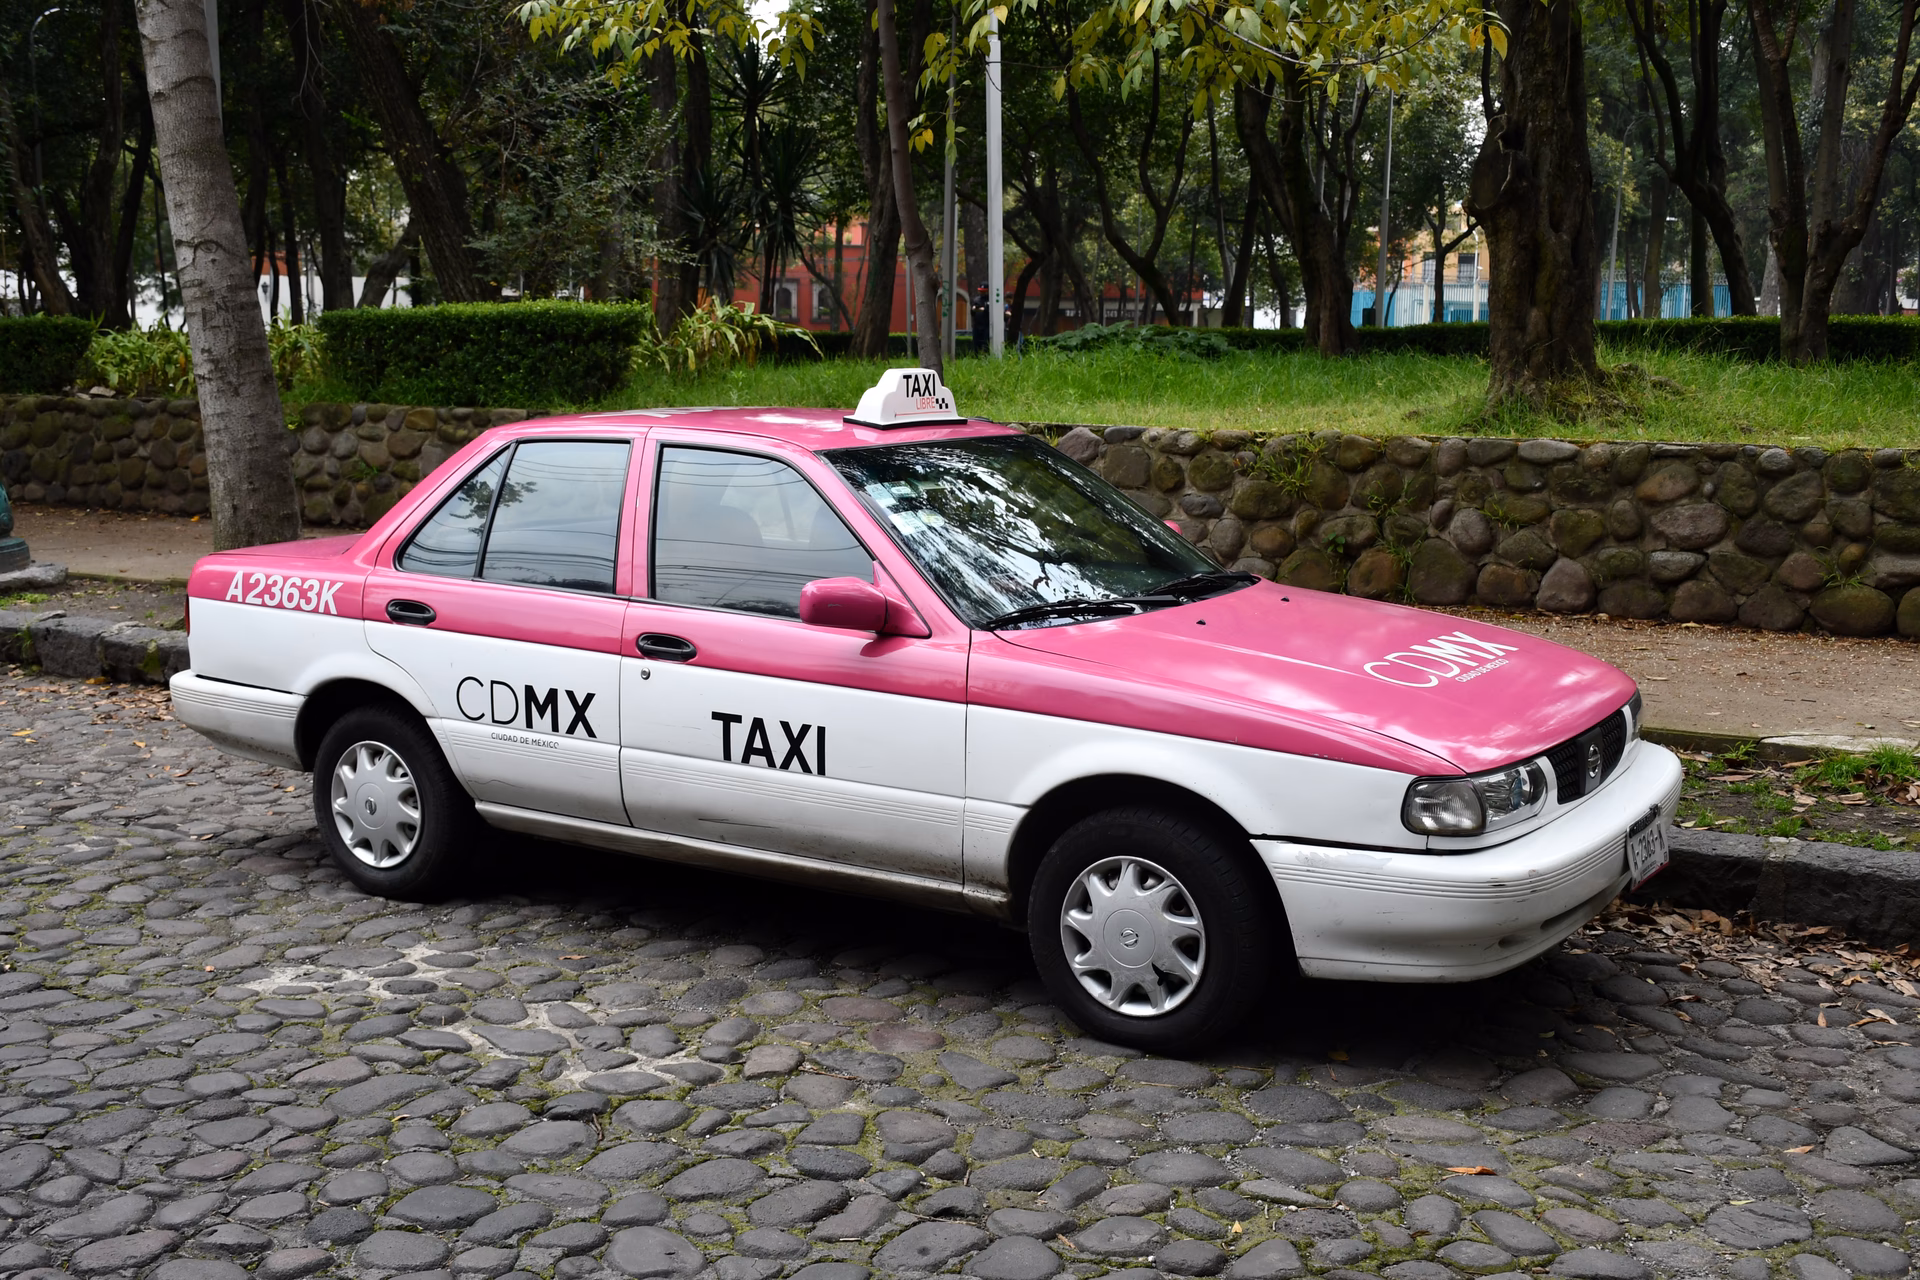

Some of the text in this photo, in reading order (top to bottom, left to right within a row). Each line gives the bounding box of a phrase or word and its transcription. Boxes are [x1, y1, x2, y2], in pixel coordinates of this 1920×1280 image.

[903, 374, 936, 398] TAXI
[916, 397, 935, 410] LIBRE
[225, 570, 344, 615] A2363K
[1363, 631, 1519, 688] CDMX
[456, 676, 597, 739] CDMX
[491, 732, 518, 743] CIUDAD
[519, 736, 530, 745] DE
[711, 711, 826, 776] TAXI
